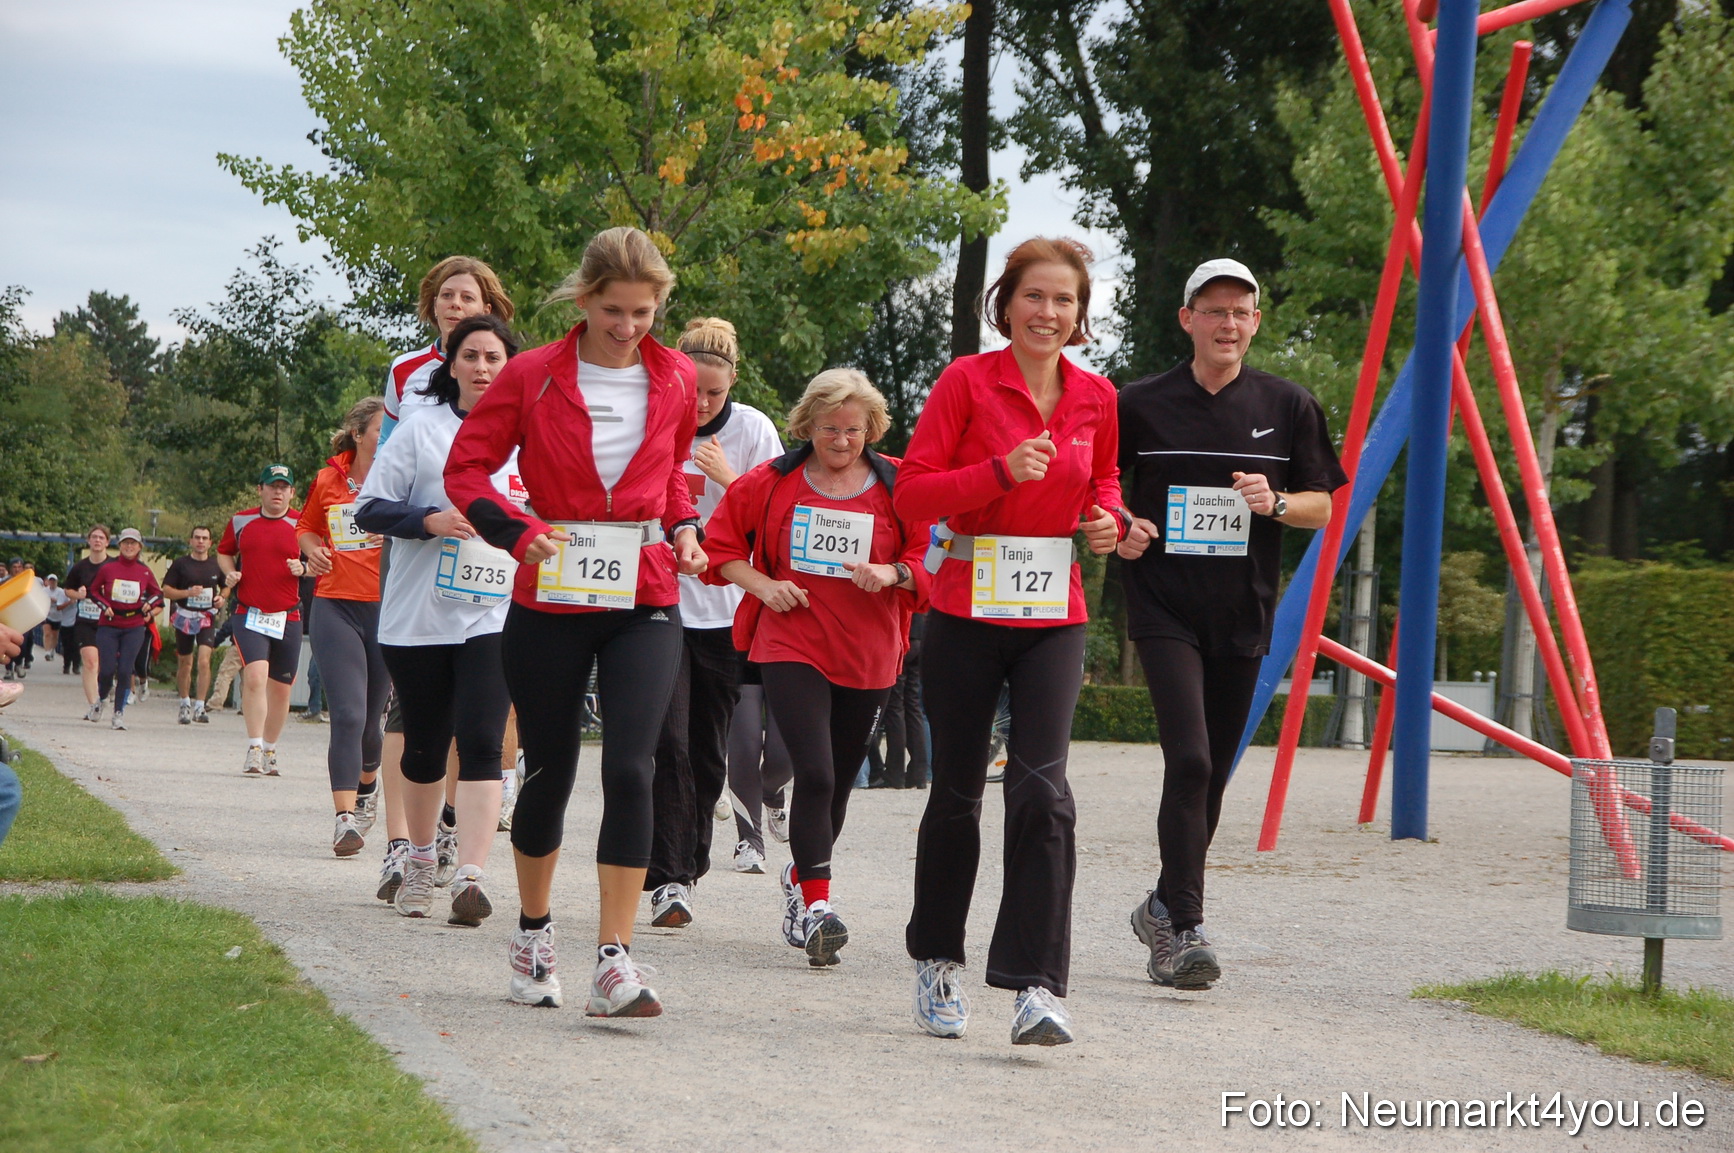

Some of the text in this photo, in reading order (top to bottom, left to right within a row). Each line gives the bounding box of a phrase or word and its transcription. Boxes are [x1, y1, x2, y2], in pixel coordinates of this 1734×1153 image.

[1193, 494, 1235, 507] Joachim
[815, 513, 851, 530] Thersia
[1193, 513, 1242, 532] 2714
[569, 532, 596, 548] Dani
[812, 533, 860, 555] 2031
[1001, 545, 1033, 564] Tanja
[461, 564, 506, 585] 3735
[577, 557, 622, 582] 126
[1011, 570, 1053, 592] 127
[122, 589, 136, 597] 936
[258, 616, 281, 629] 2435
